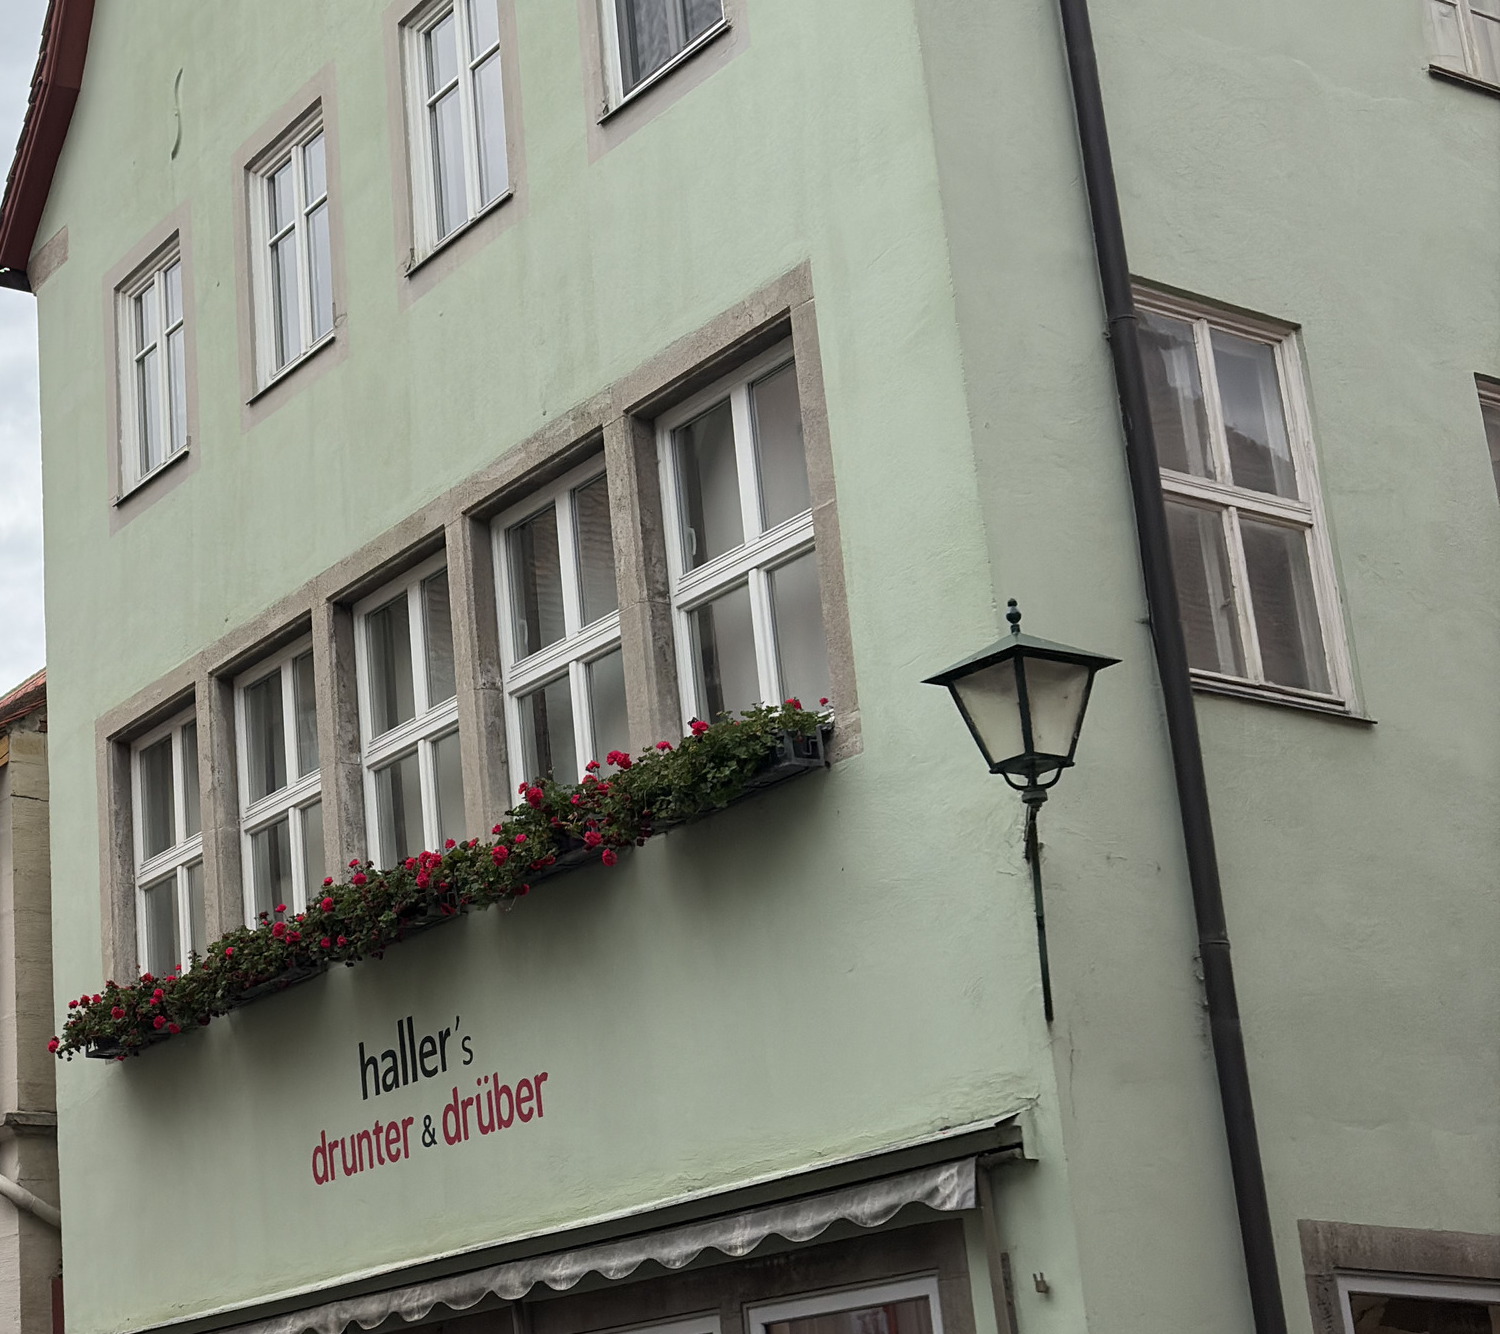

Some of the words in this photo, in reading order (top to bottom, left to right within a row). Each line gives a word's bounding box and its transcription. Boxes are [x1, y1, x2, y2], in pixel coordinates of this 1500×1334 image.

[312, 1115, 415, 1185] drunter
[421, 1114, 438, 1148] &
[442, 1071, 549, 1147] drüber
